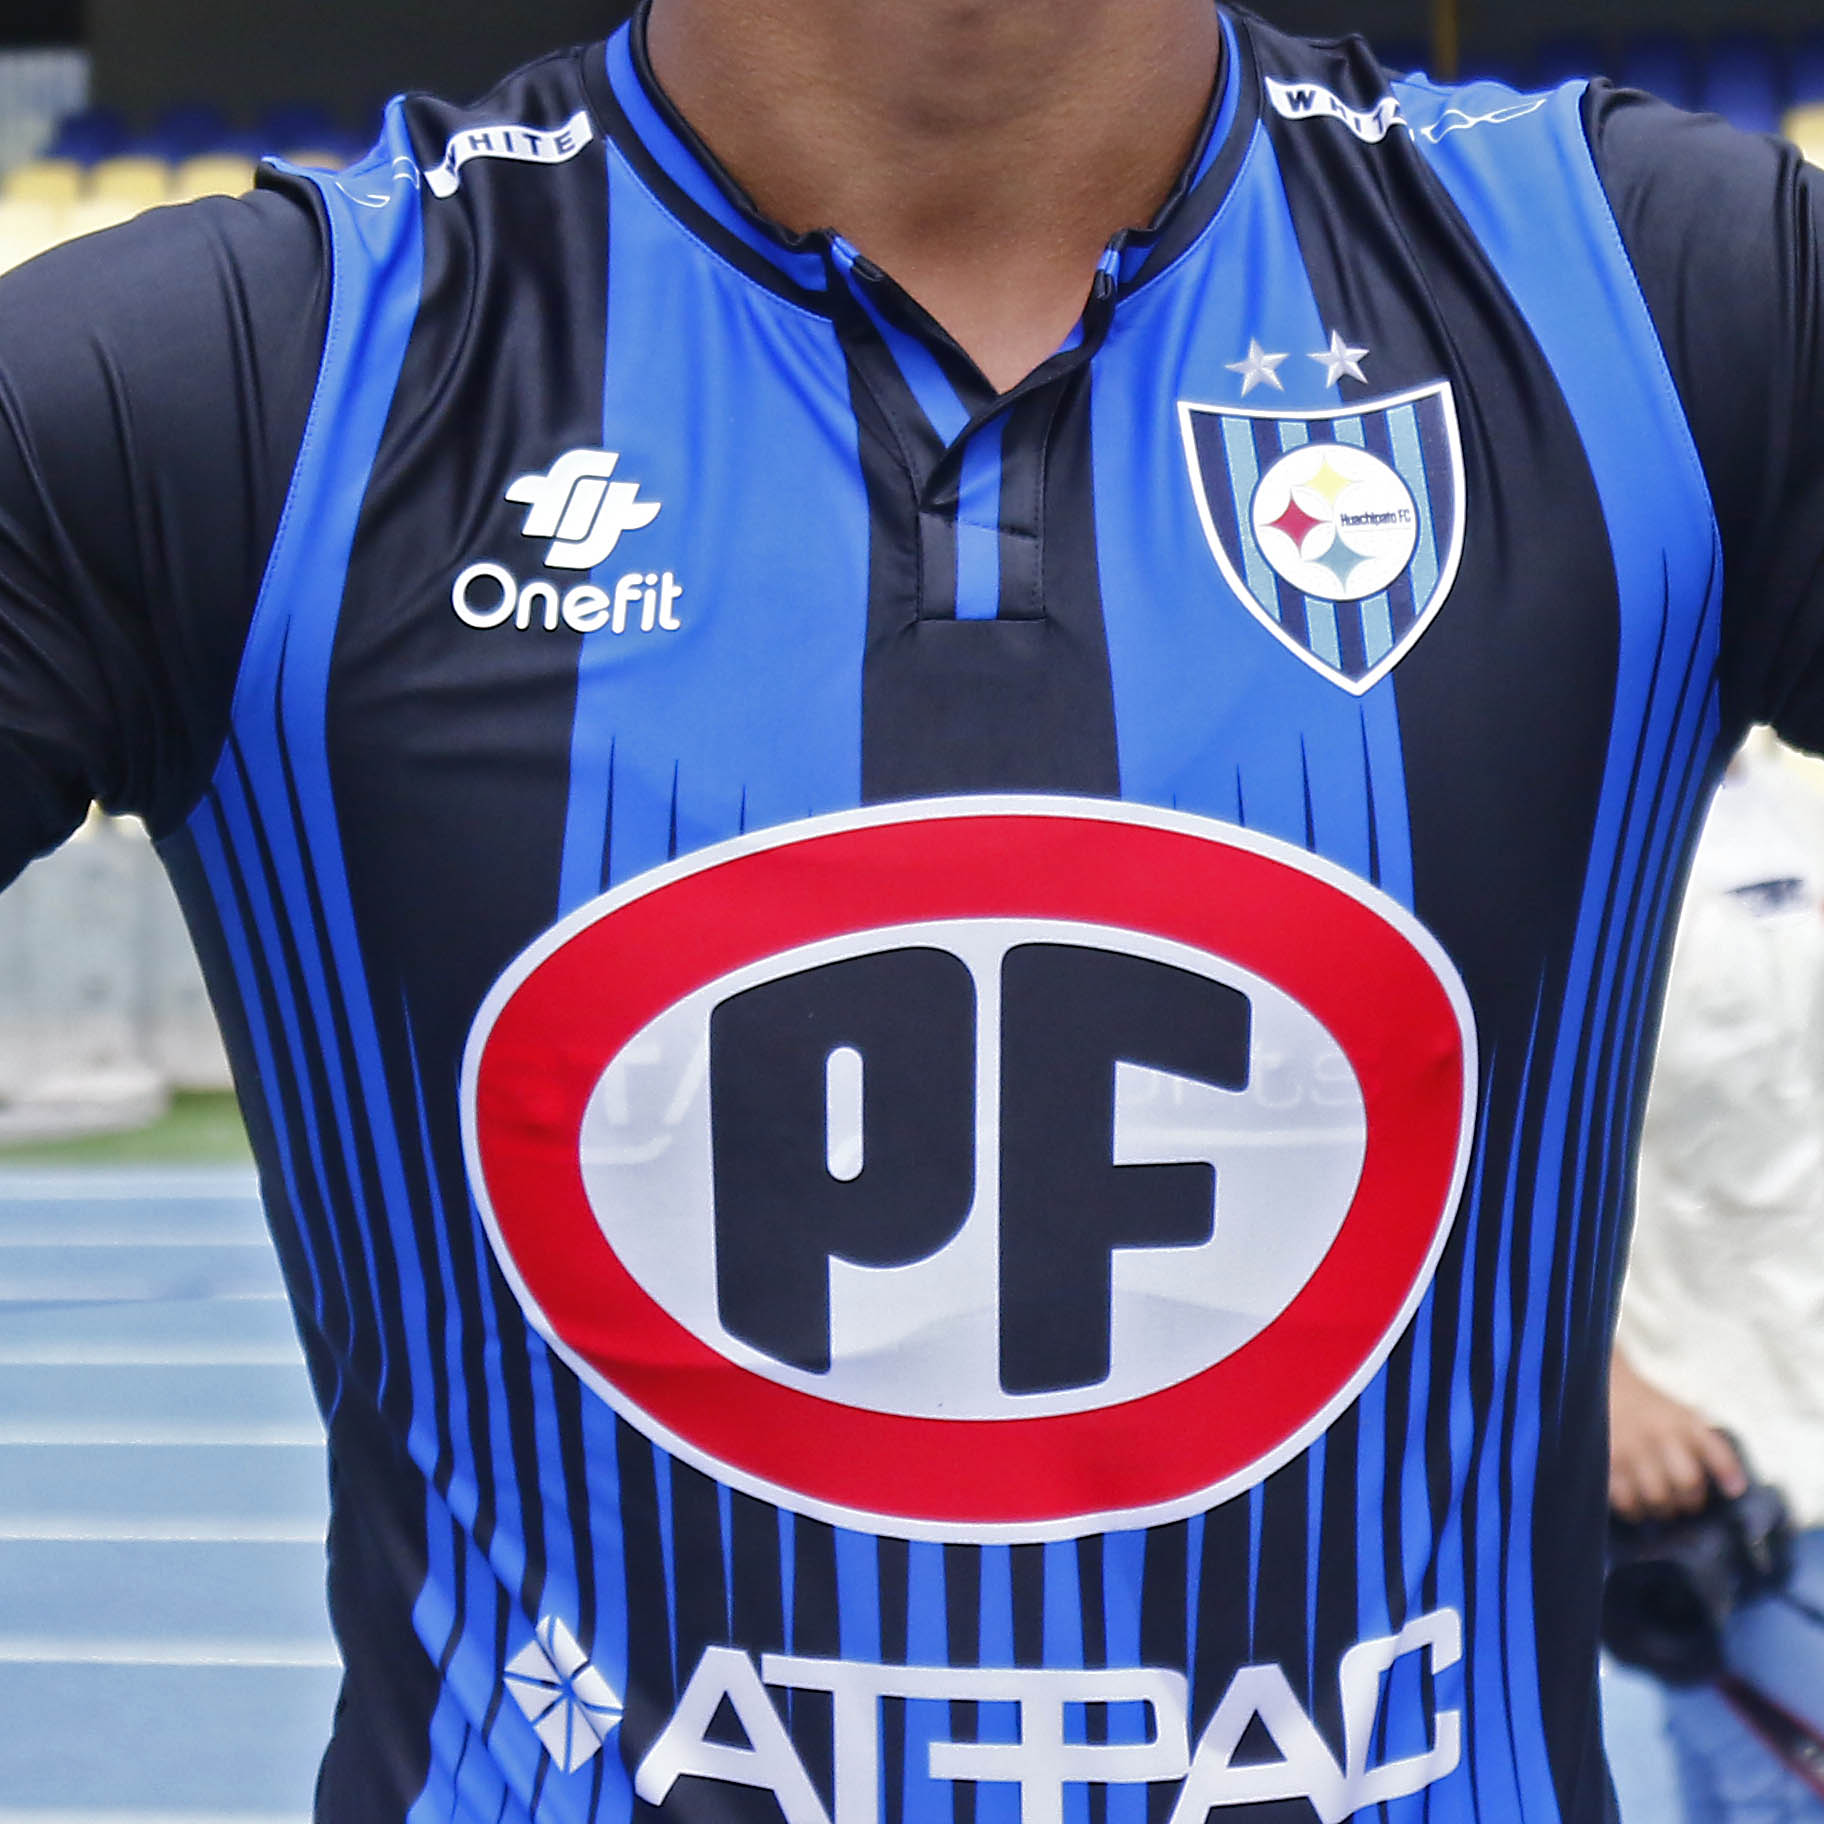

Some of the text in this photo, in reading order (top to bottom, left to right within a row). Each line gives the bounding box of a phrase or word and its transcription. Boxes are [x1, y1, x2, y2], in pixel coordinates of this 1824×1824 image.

[1340, 508, 1412, 527] Huachipato FC
[452, 562, 683, 634] Onefit
[709, 940, 1253, 1397] PF
